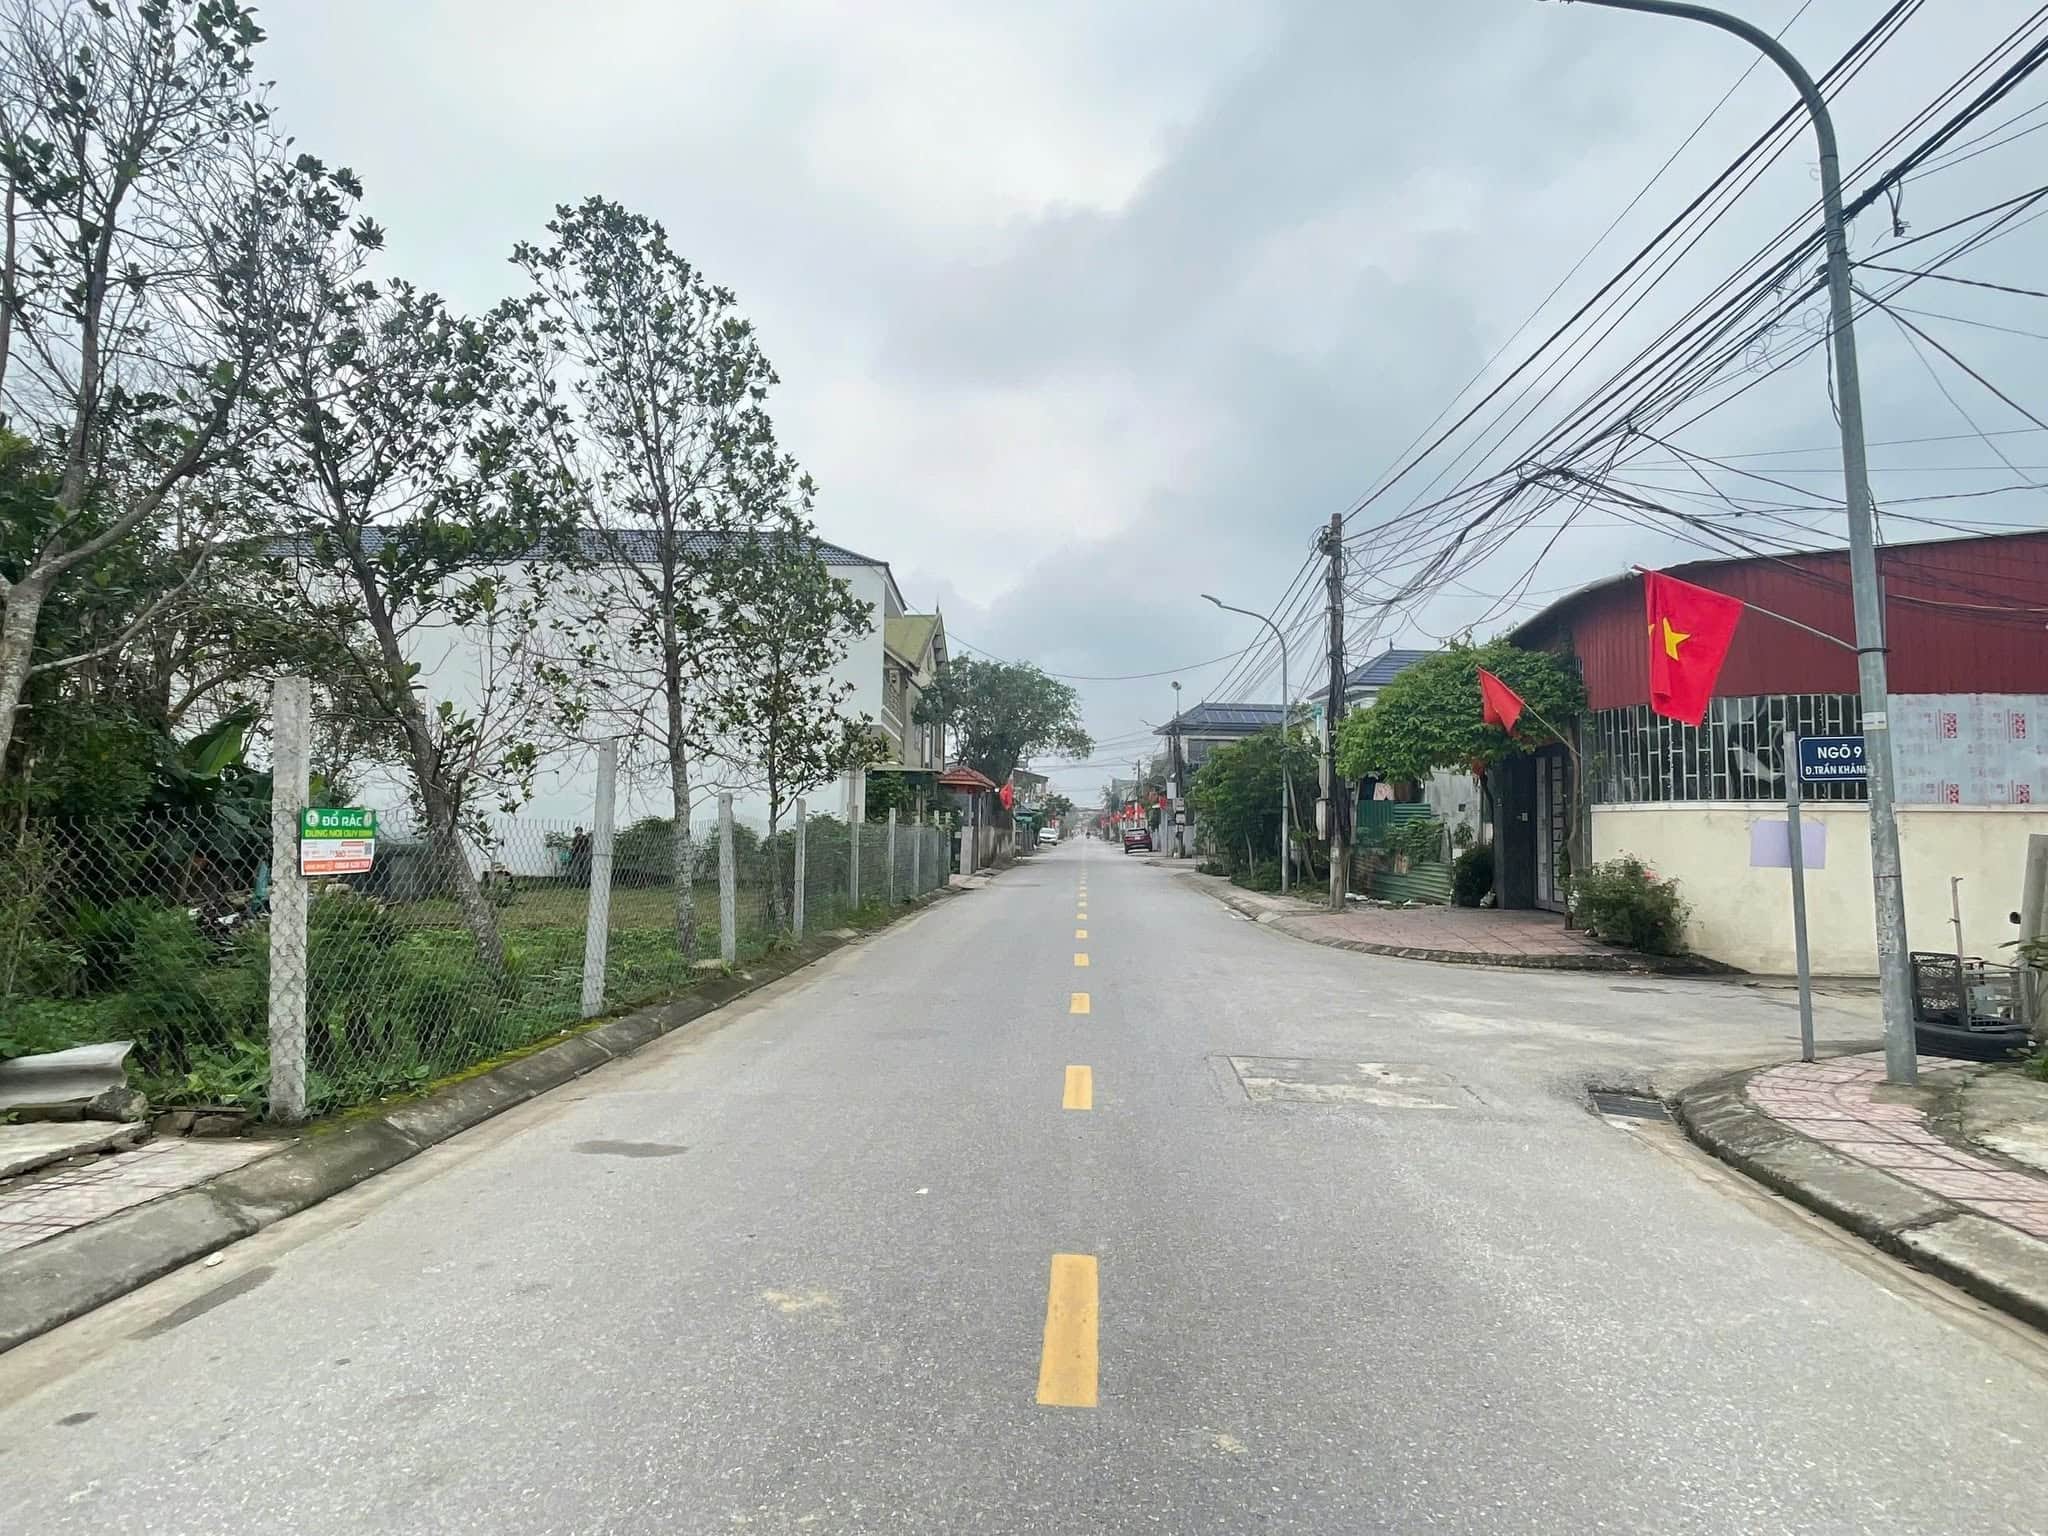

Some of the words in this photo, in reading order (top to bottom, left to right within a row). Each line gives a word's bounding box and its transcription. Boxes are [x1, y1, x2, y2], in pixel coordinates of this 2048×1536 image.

[1817, 743, 1851, 759] NGÕ
[1853, 746, 1862, 758] 9
[322, 810, 338, 827] ĐỔ
[341, 813, 363, 827] RÁC
